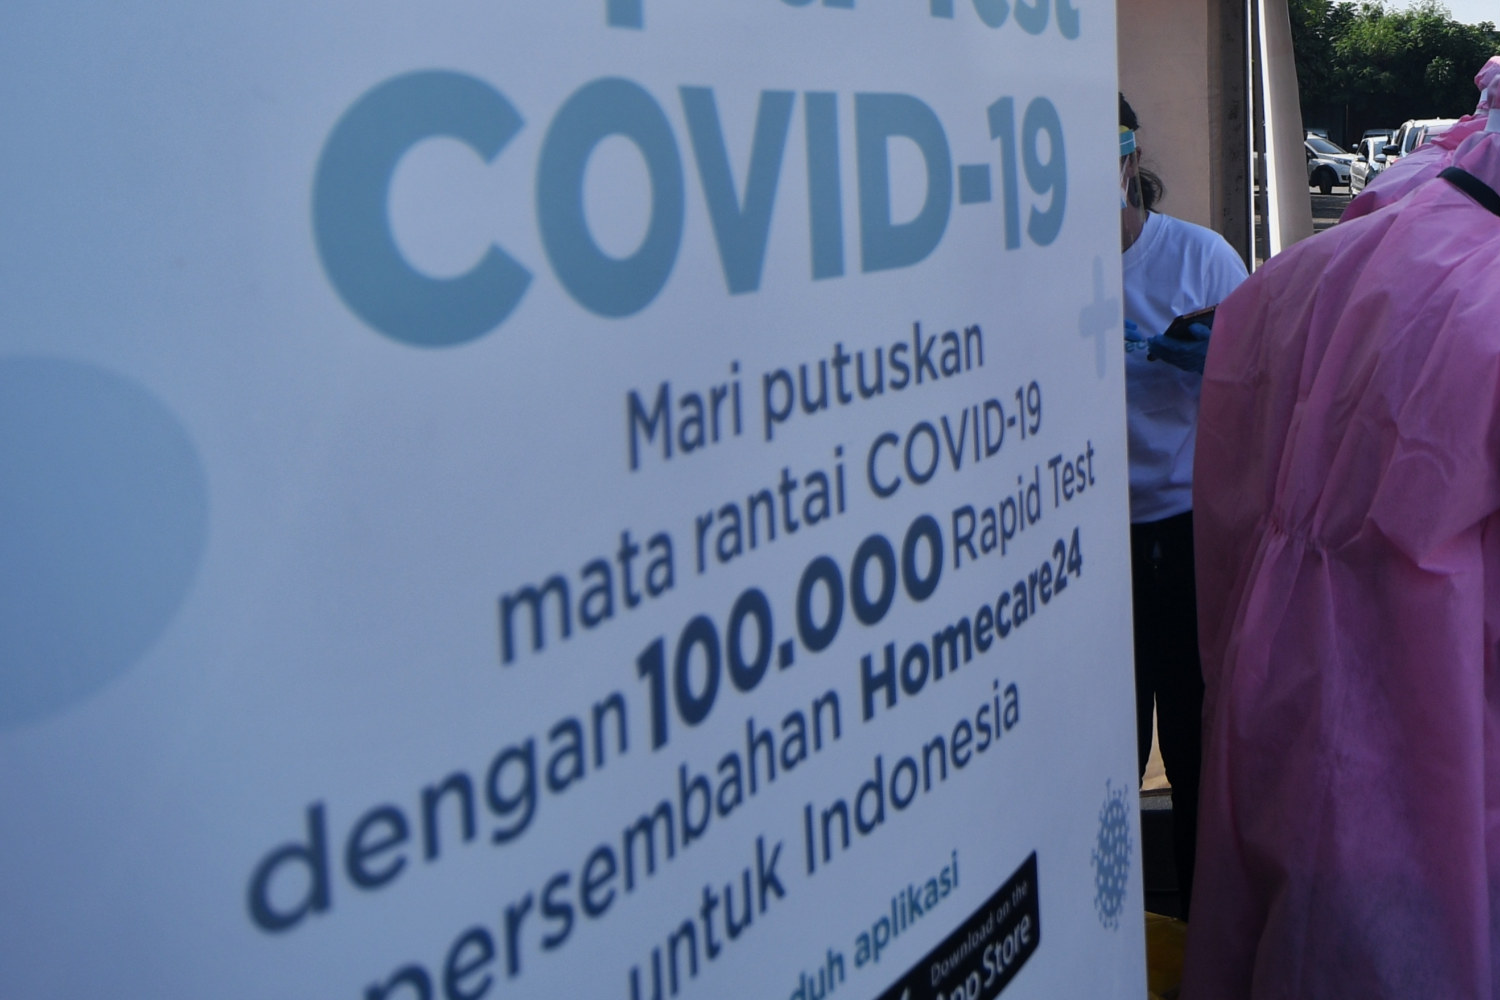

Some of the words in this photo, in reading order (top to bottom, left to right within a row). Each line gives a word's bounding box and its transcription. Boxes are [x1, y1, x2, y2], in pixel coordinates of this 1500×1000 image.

[310, 67, 1068, 350] COVID-19
[625, 359, 744, 473] Mari
[761, 319, 985, 442] putuskan
[497, 529, 676, 668] mata
[694, 444, 847, 575] rantai
[866, 379, 1043, 500] COVID-19
[245, 690, 630, 937] dengan
[634, 512, 946, 753] 100.000
[951, 464, 1042, 571] Rapid
[1047, 438, 1096, 510] Test
[860, 525, 1083, 723] Homecare24
[802, 678, 1021, 876] Indonesia
[853, 849, 960, 969] aplikasi
[930, 911, 994, 987] Download
[996, 902, 1012, 924] on
[1011, 880, 1029, 909] the
[982, 914, 1031, 988] Store
